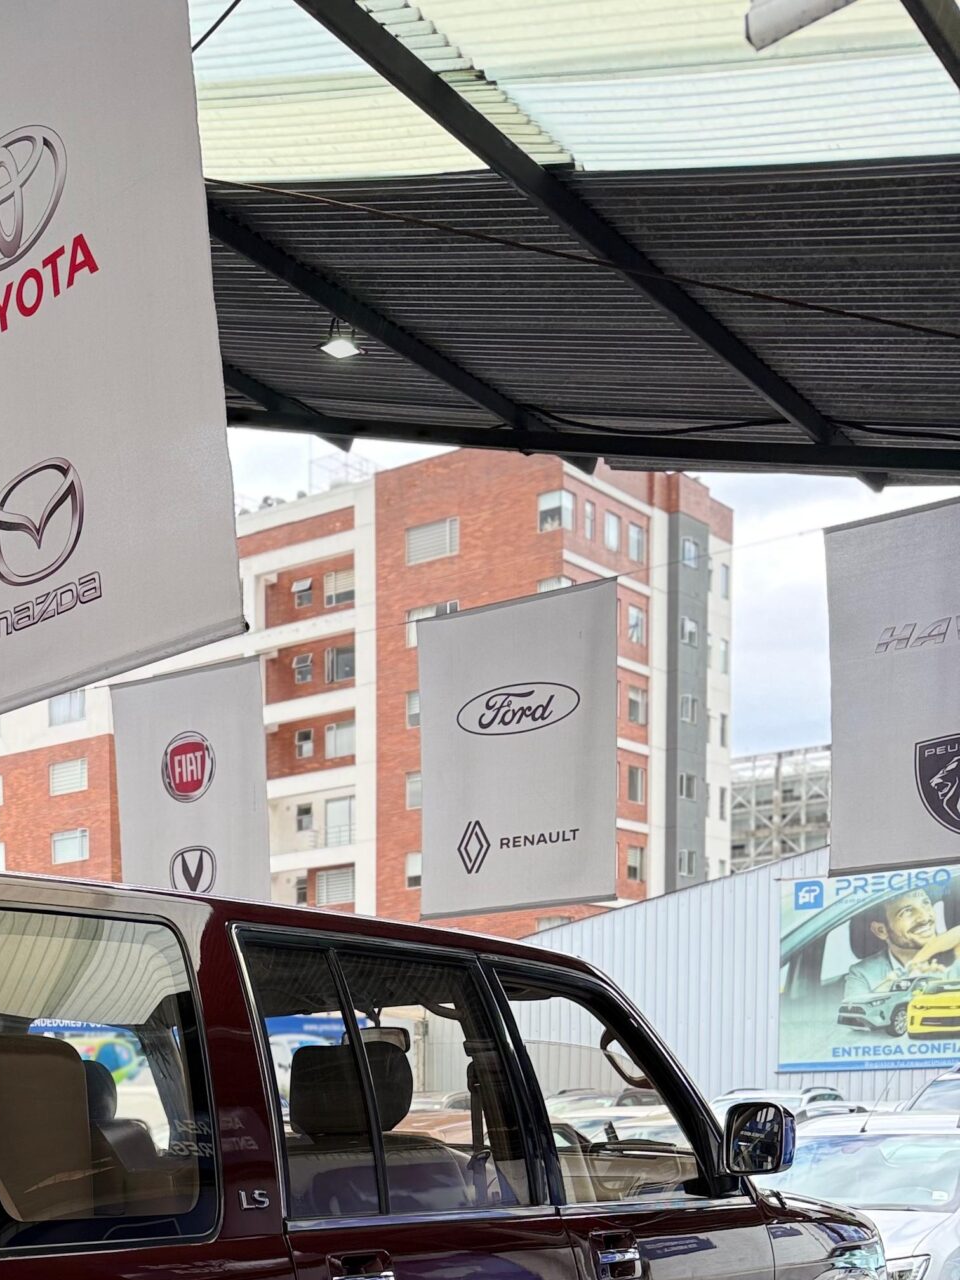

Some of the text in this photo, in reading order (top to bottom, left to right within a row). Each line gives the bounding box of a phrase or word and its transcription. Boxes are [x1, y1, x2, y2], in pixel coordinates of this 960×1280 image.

[874, 614, 960, 654] HA
[478, 689, 556, 730] Ford
[924, 742, 960, 758] PEU
[173, 750, 203, 784] FIAT
[499, 827, 580, 850] RENAULT
[834, 867, 952, 897] PRECISO
[831, 1040, 960, 1058] ENTREGA CONFI
[238, 1189, 271, 1211] LS
